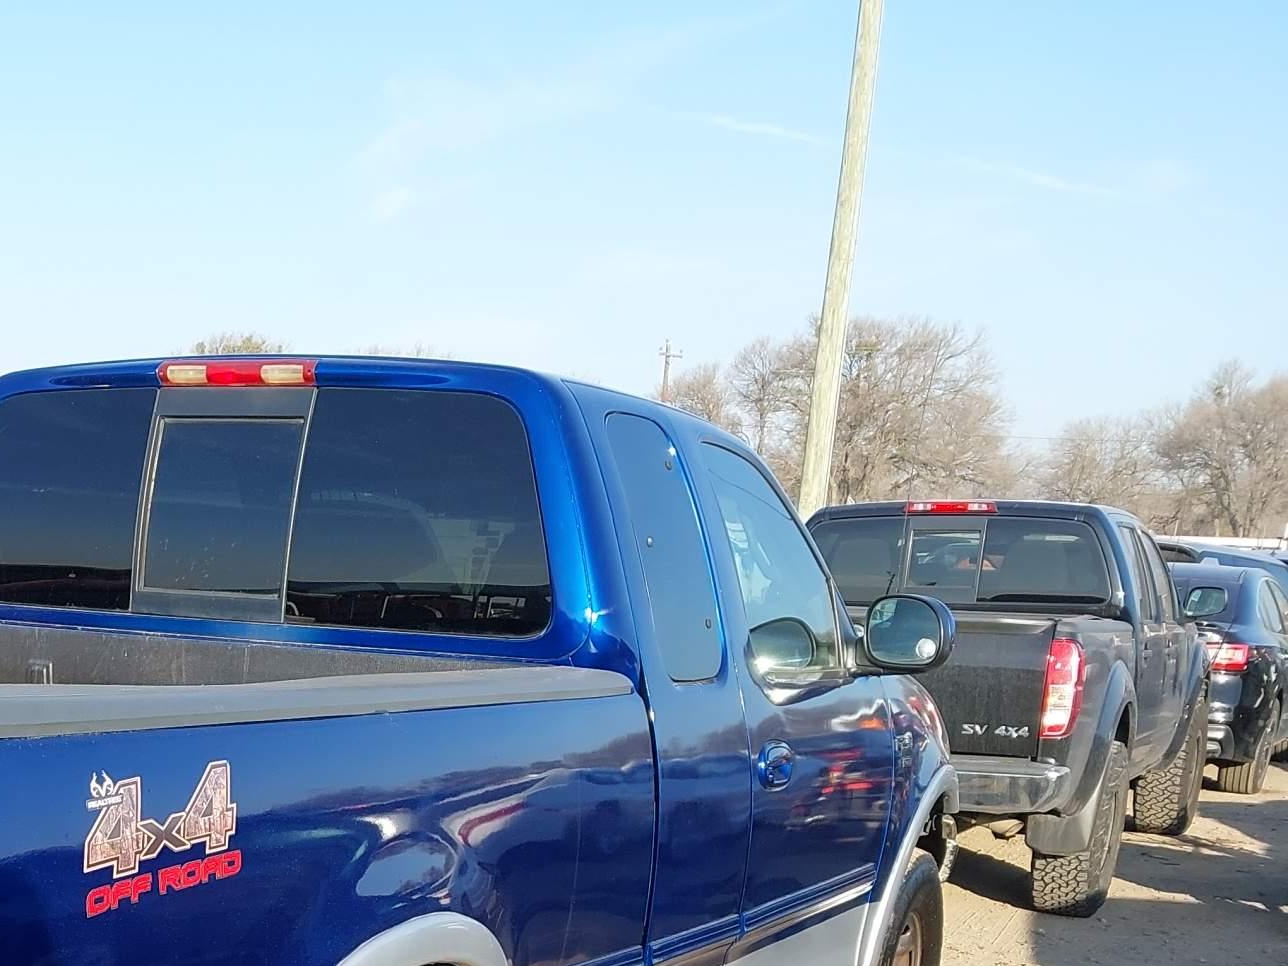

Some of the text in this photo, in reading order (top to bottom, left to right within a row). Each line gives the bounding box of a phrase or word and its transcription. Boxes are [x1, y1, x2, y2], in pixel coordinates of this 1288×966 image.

[961, 723, 989, 735] SV
[85, 849, 242, 918] OFF ROAD
